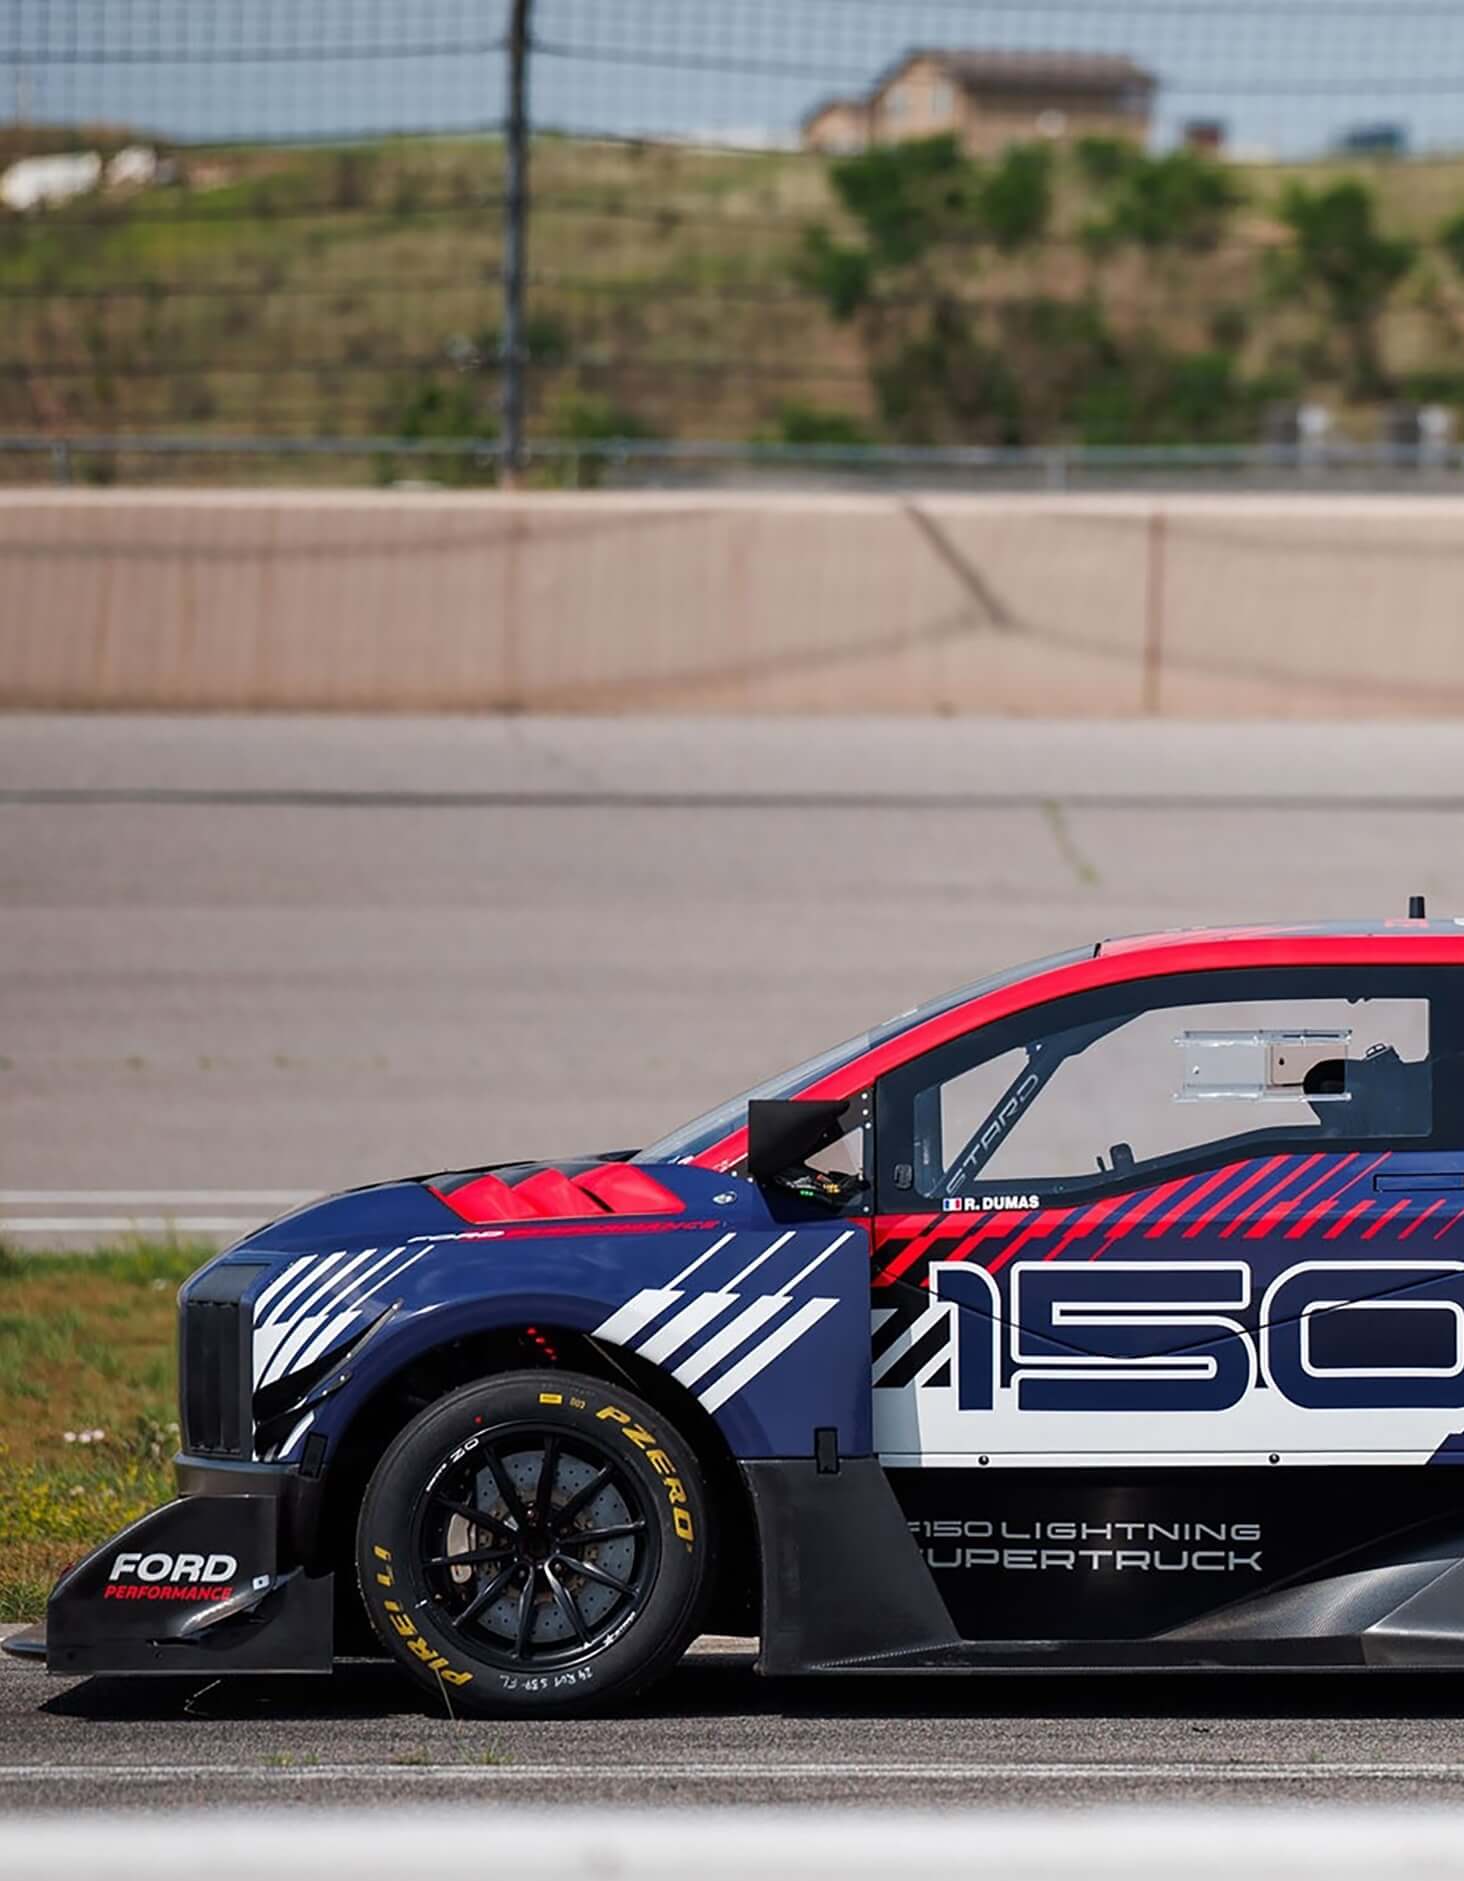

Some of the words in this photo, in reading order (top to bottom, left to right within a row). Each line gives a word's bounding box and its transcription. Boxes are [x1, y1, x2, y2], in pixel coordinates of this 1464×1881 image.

[946, 1074, 1039, 1195] STARD
[964, 1198, 980, 1211] R.
[983, 1196, 1040, 1210] DUMAS
[1001, 1522, 1261, 1541] LIGHTNING
[109, 1553, 237, 1582] FORD
[920, 1548, 1263, 1571] UPERTRUCK
[104, 1585, 233, 1601] PERFORMANCE
